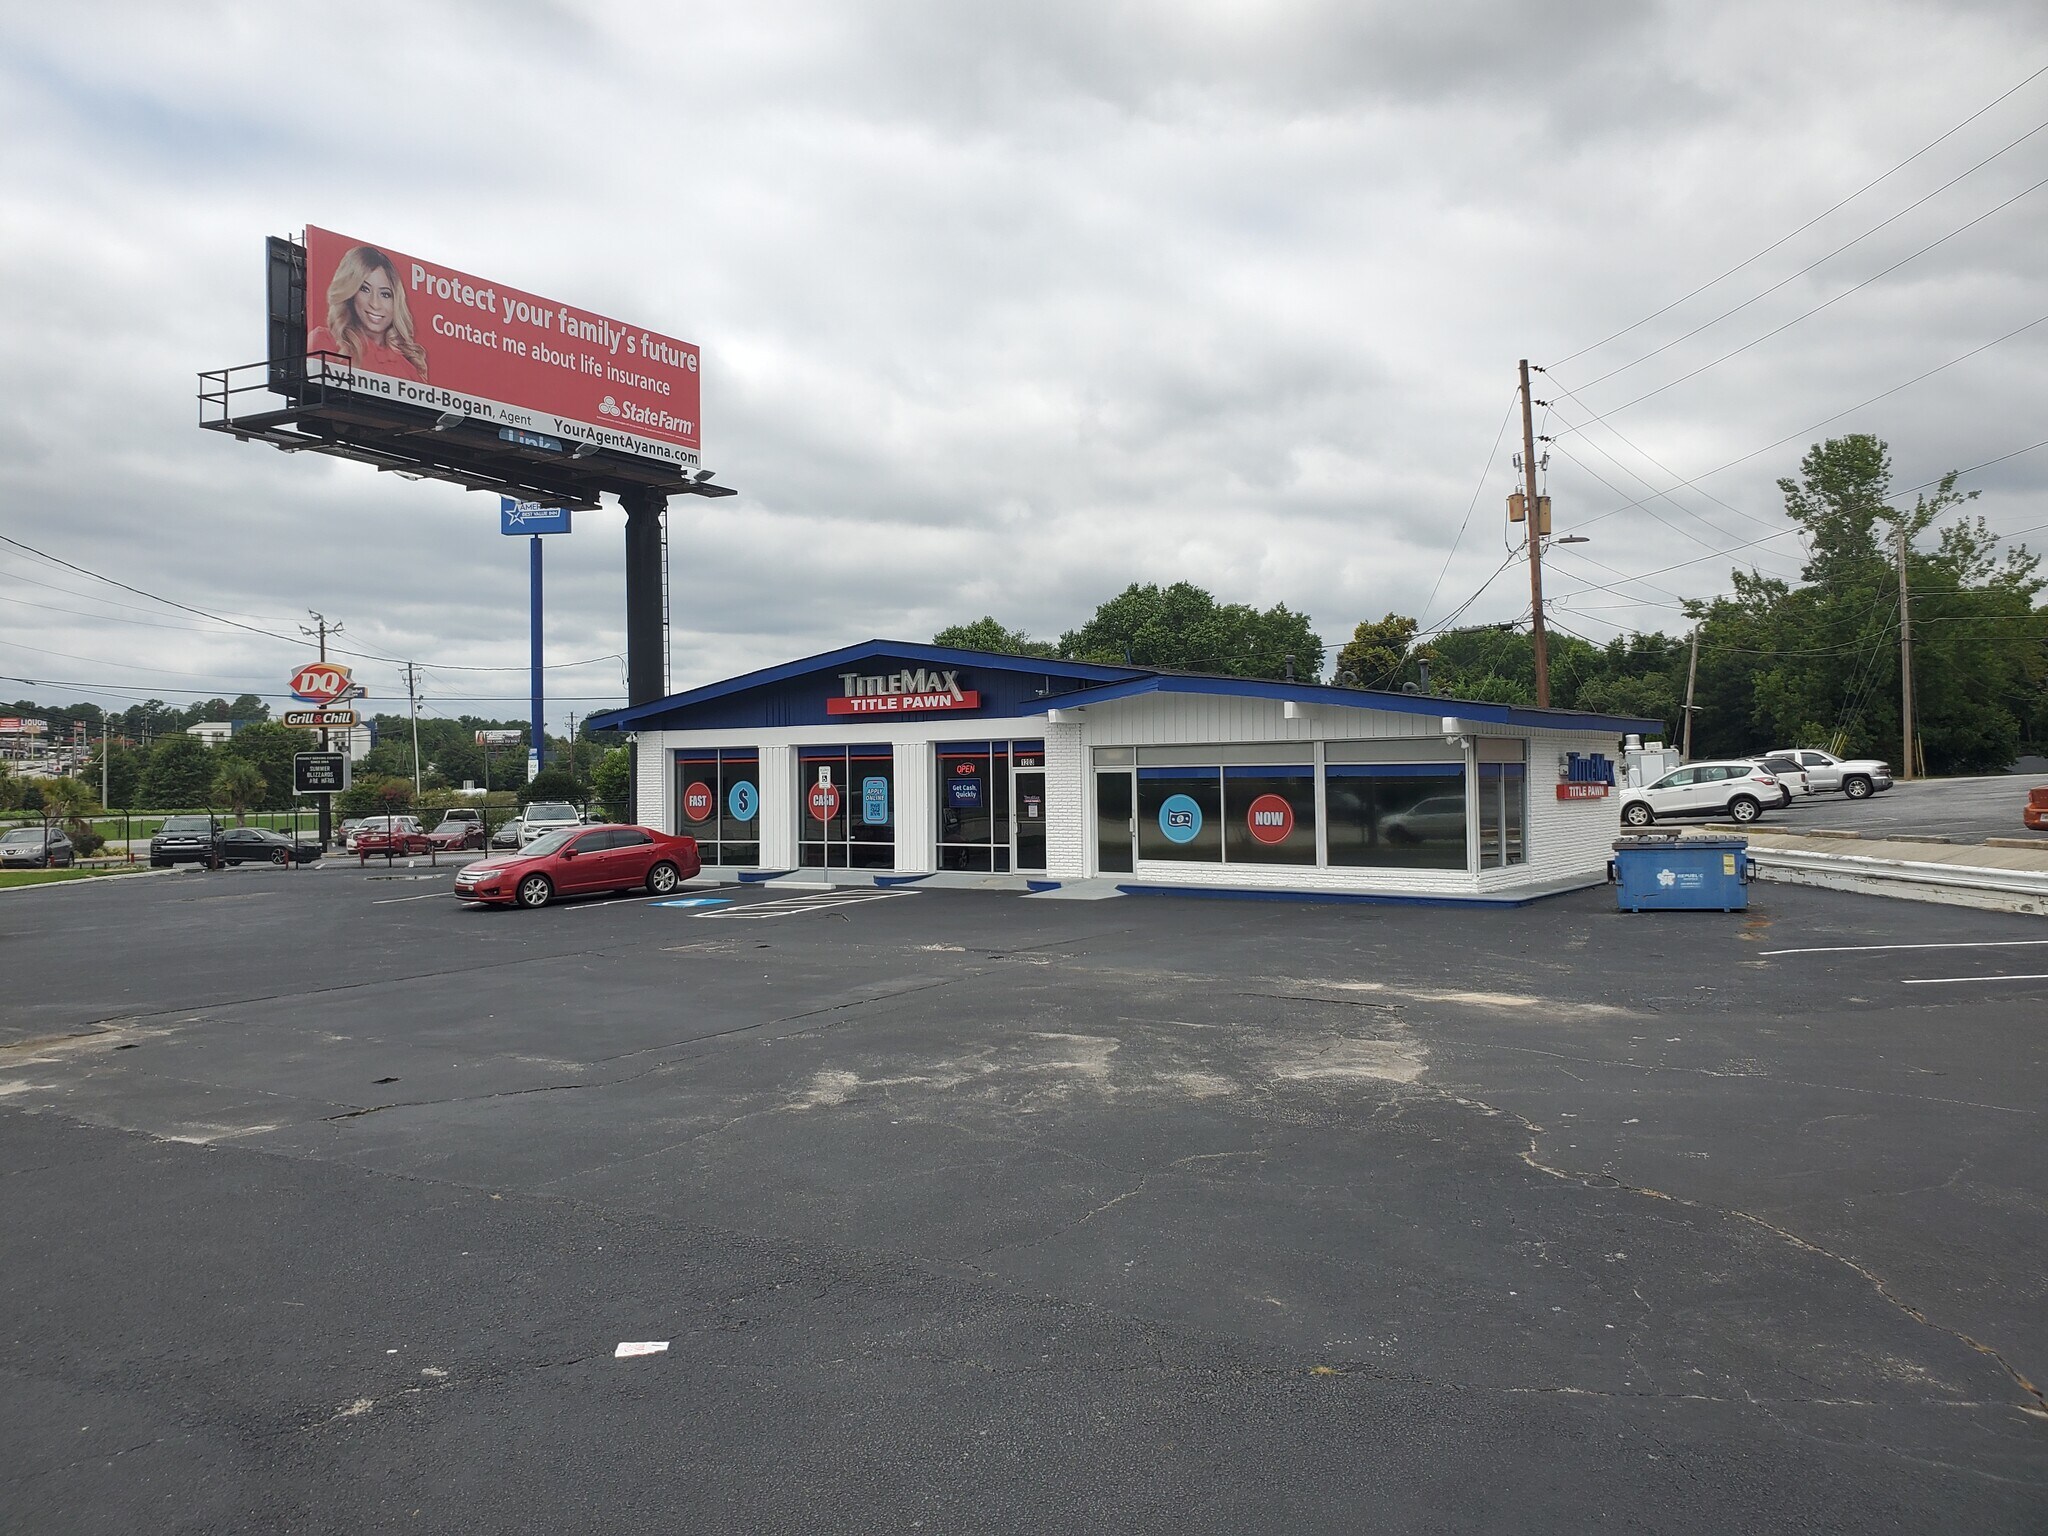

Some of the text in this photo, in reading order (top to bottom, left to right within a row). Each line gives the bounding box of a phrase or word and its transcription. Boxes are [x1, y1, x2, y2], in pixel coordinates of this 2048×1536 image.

[411, 263, 698, 373] Protect your family's future
[432, 314, 671, 396] Contact me about life insurance
[322, 365, 391, 395] Ayanna
[499, 411, 532, 427] Agent
[553, 418, 699, 465] YourAgentAyanna.com
[298, 672, 341, 695] DQ
[851, 695, 951, 711] TITLE PAWN
[956, 765, 975, 773] OPEN
[955, 790, 976, 798] Quickly
[1569, 786, 1604, 796] TITLE PAWN
[689, 795, 707, 807] FAST
[1255, 811, 1284, 826] NOW
